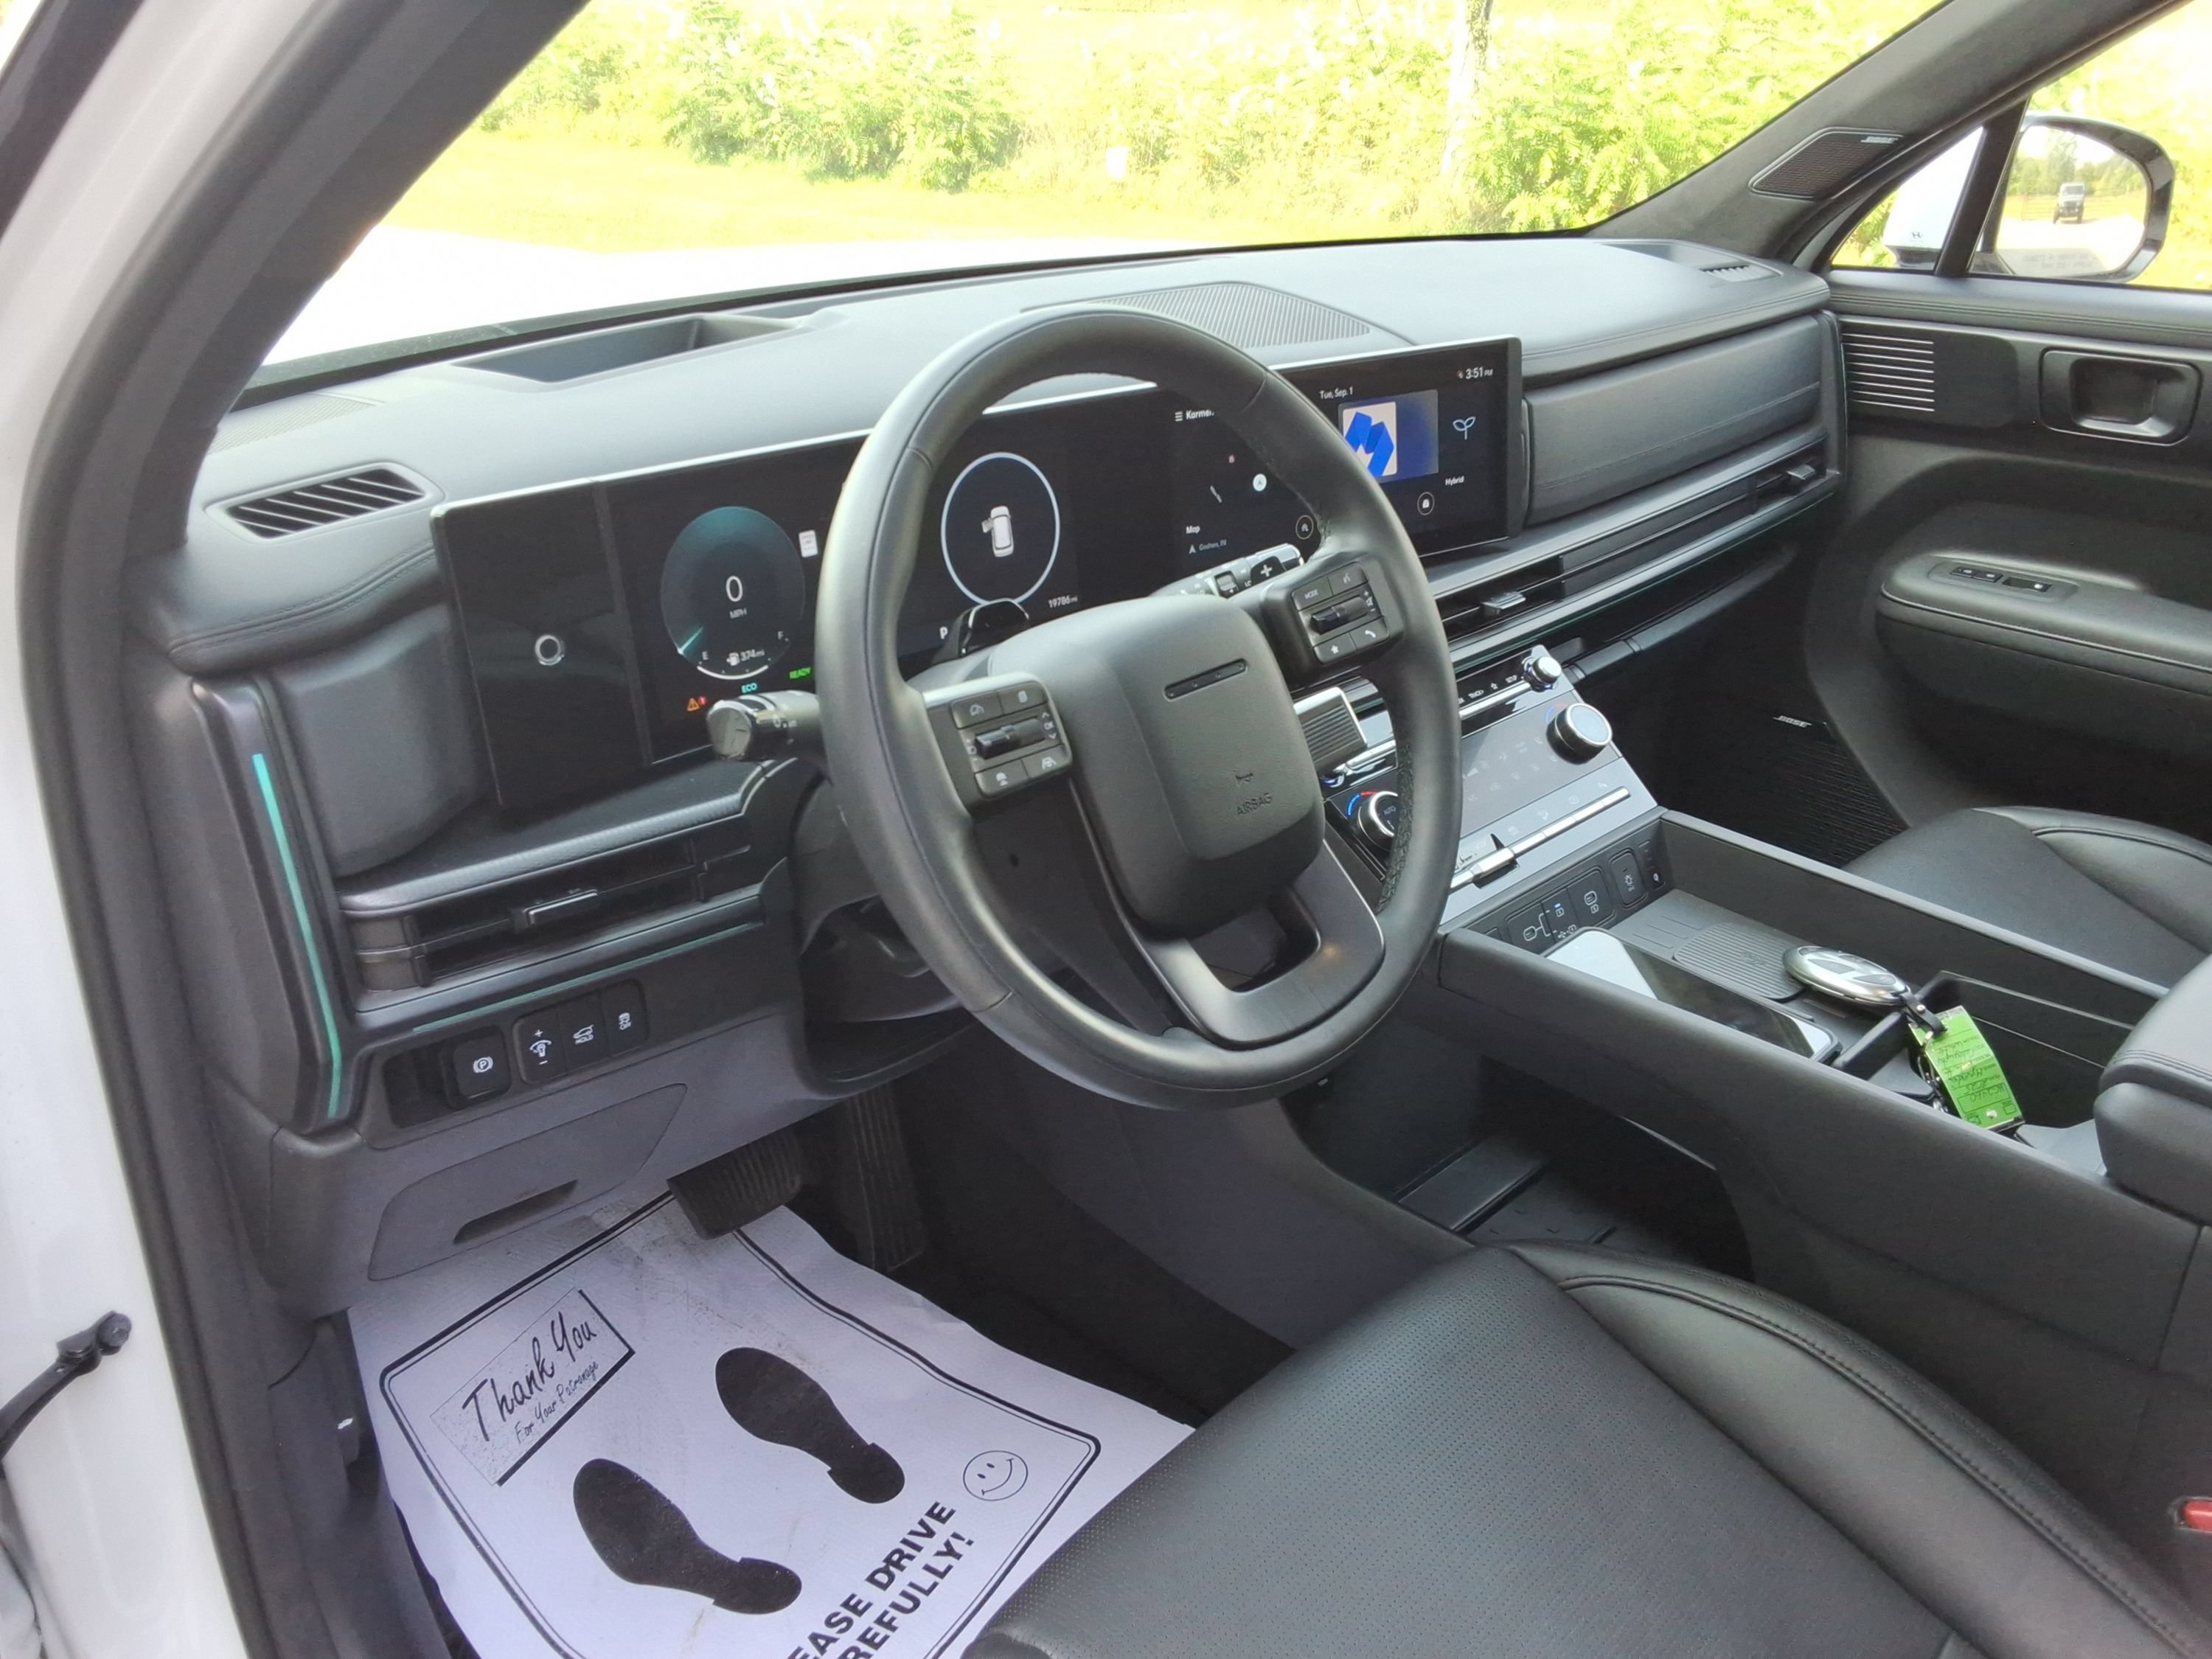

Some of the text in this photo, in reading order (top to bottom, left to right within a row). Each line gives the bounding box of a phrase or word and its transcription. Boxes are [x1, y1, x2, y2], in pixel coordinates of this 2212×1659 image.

[1445, 475, 1465, 487] Hybrid
[1186, 525, 1200, 535] Map
[725, 575, 744, 602] 0
[729, 608, 748, 619] MPH
[940, 626, 948, 639] P
[740, 682, 758, 694] ECO
[1235, 792, 1275, 815] AIRBAG
[575, 1034, 594, 1045] HOLD
[462, 1311, 597, 1441] Thank You
[515, 1361, 599, 1444] For Your Patronage
[864, 1501, 956, 1592] DRIVE
